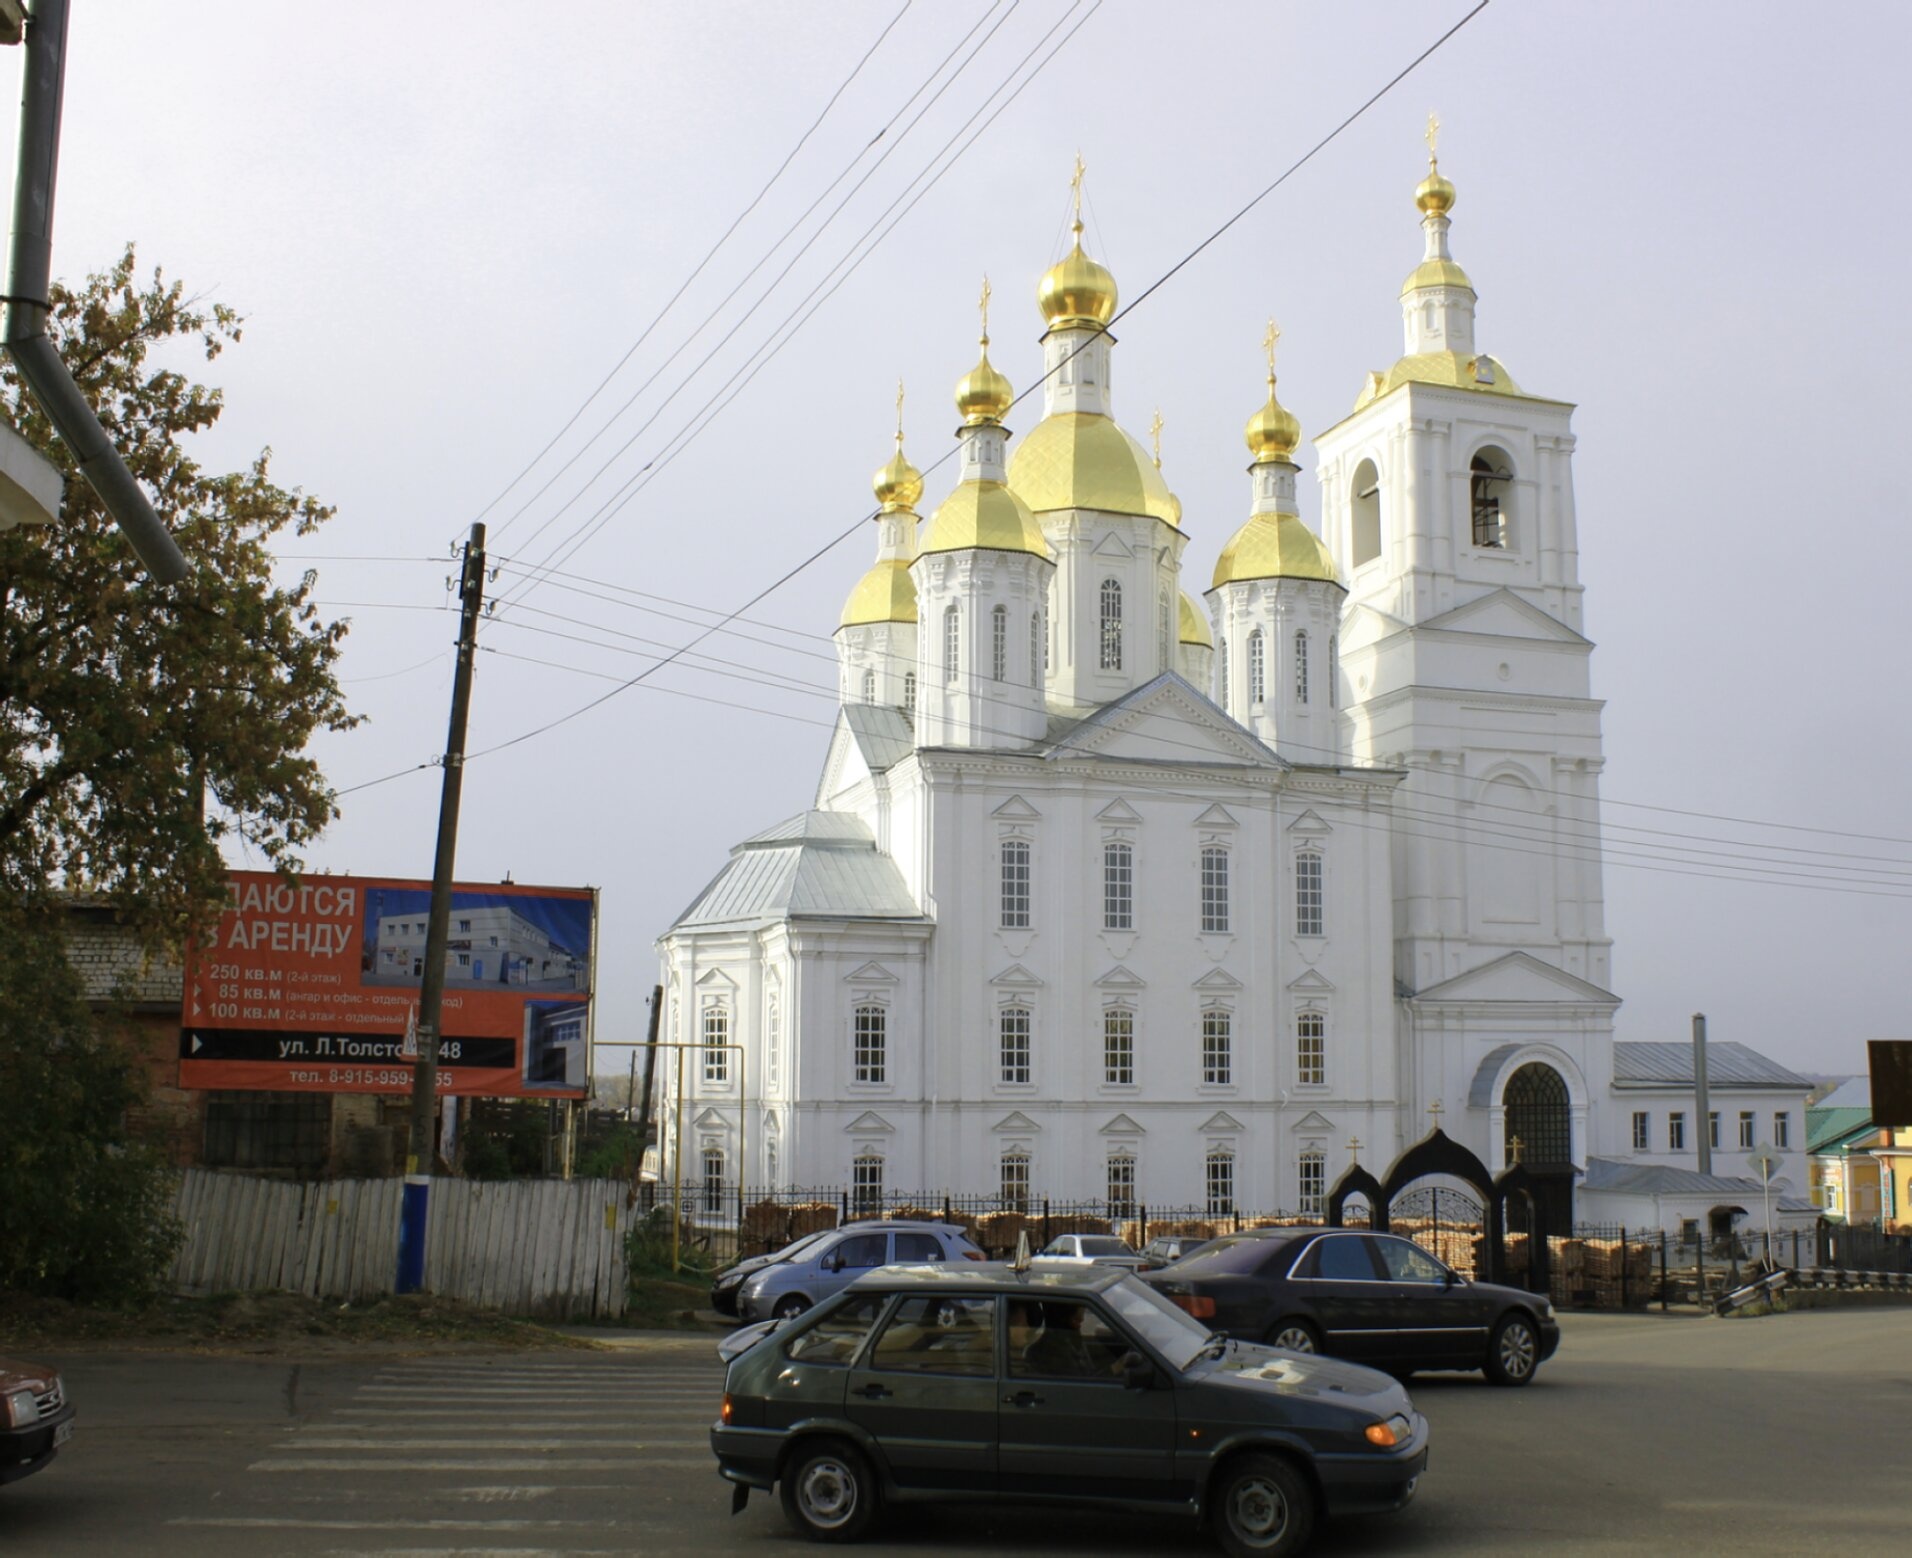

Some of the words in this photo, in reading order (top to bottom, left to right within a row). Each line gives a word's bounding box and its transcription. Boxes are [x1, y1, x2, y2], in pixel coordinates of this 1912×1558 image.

[207, 881, 356, 917] ДАЮТСЯ
[227, 919, 352, 959] АРЕНДУ
[209, 964, 240, 980] 250
[244, 968, 283, 981] кв.м
[311, 974, 342, 986] этаж)
[219, 983, 239, 999] 85
[243, 987, 281, 1000] кв.м
[323, 993, 331, 1001] и
[332, 991, 363, 1005] офис
[209, 1002, 238, 1018] 100
[243, 1006, 281, 1019] кв.м
[309, 1012, 337, 1021] этаж
[279, 1040, 310, 1058] ул.
[438, 1041, 462, 1059] 48
[289, 1071, 324, 1083] тел.
[329, 1069, 453, 1088] 8-915-959-55
